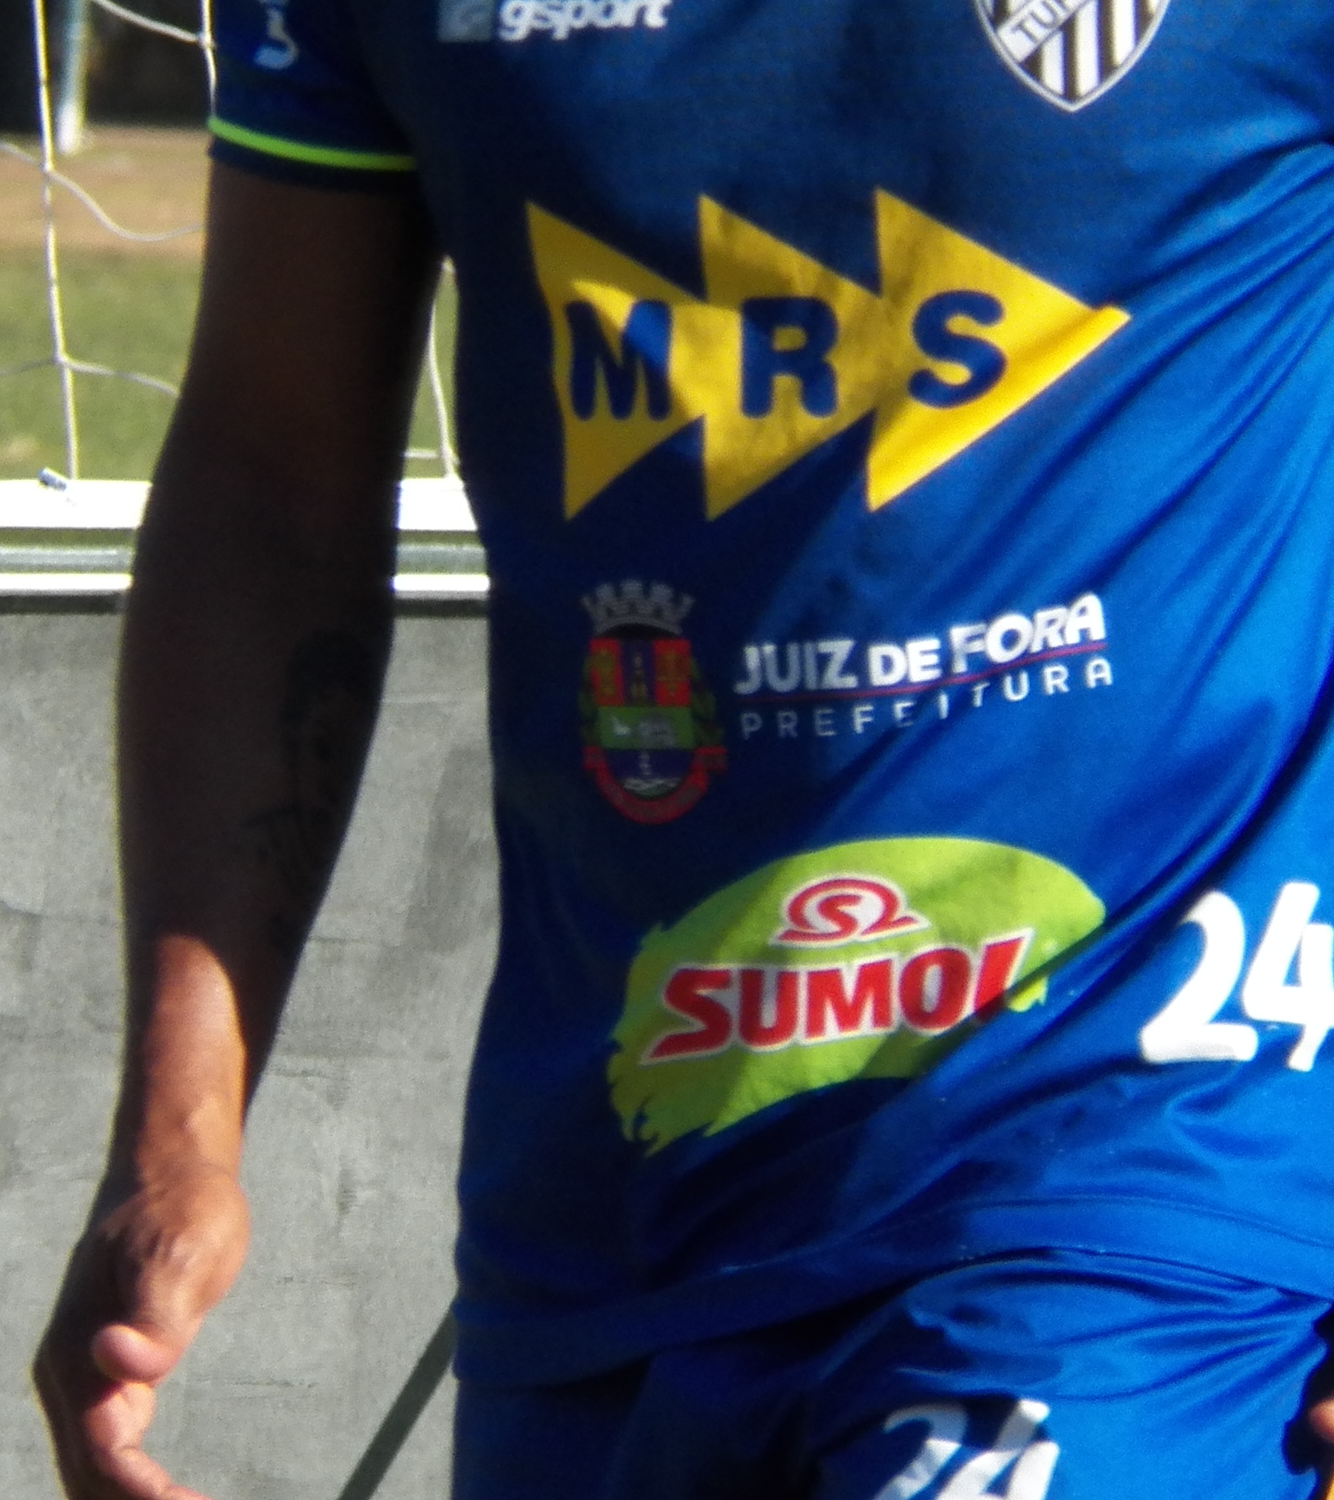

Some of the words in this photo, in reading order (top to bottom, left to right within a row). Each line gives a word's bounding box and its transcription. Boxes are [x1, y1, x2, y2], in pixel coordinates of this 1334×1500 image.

[733, 639, 858, 694] JUIZ
[868, 637, 941, 687] DE
[949, 591, 1106, 673] FORA
[741, 658, 1113, 739] PREFEITURA
